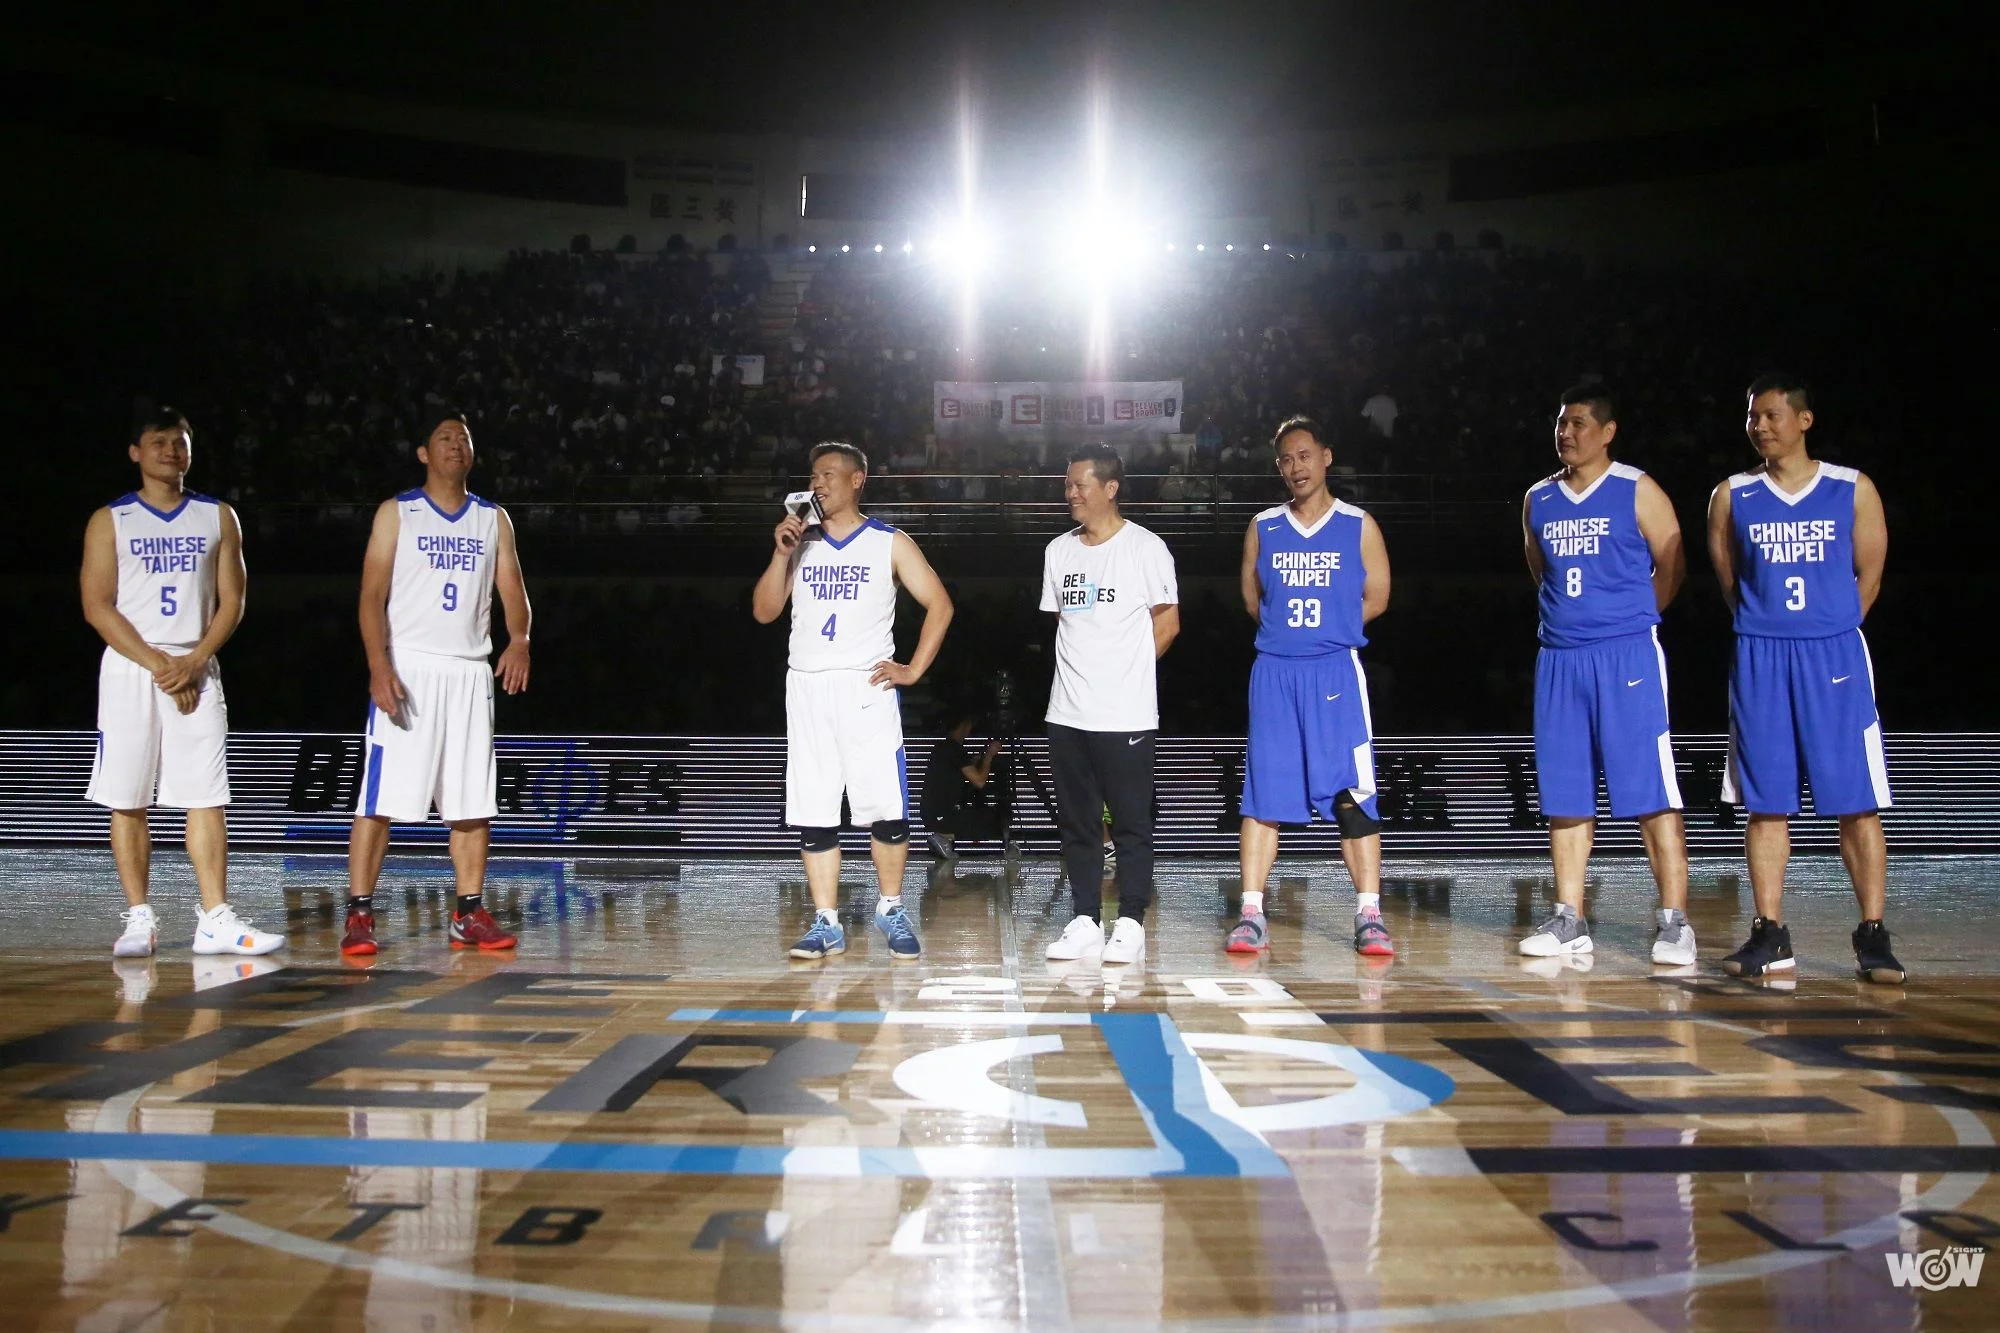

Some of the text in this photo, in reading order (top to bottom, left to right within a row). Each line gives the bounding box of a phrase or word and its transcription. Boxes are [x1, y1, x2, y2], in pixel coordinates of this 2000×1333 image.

[1543, 517, 1610, 540] CHINESE
[1748, 520, 1836, 543] CHINESE
[130, 536, 207, 556] CHINESE
[417, 536, 484, 556] CHINESE
[1550, 535, 1599, 557] TAIPEI
[1760, 541, 1825, 563] TAIPEI
[141, 554, 197, 574] TAIPEI
[427, 553, 477, 572] TAIPEI
[1272, 552, 1341, 570] CHINESE
[802, 565, 871, 583] CHINESE
[1063, 573, 1079, 588] BE
[1280, 569, 1330, 587] TAIPEI
[1566, 567, 1582, 598] 8
[161, 586, 177, 616] 5
[442, 582, 458, 611] 9
[810, 583, 859, 601] TAIPEI
[1785, 576, 1806, 611] 3
[1287, 598, 1321, 628] 33
[821, 612, 837, 641] 4
